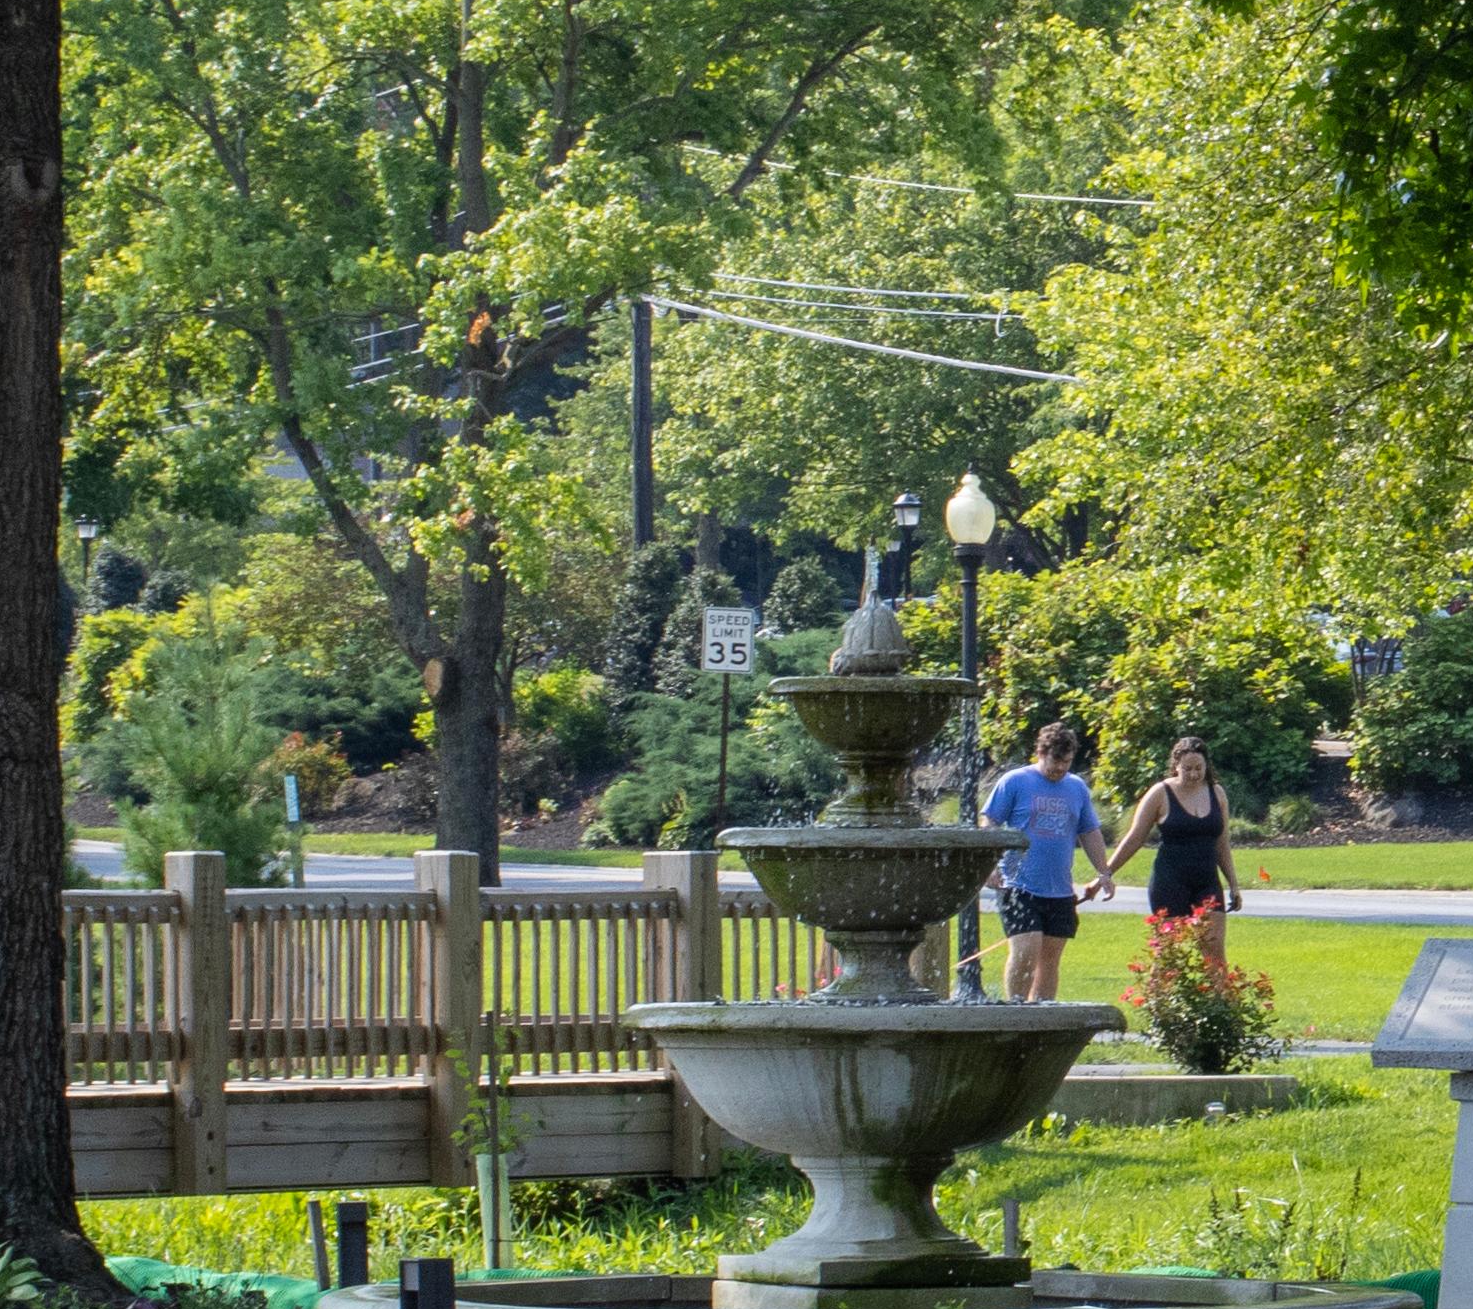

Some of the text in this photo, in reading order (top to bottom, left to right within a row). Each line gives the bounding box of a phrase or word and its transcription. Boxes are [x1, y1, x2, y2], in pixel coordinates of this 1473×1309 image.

[708, 615, 750, 626] SPEED
[712, 628, 745, 639] LIMIT
[708, 641, 747, 665] 35
